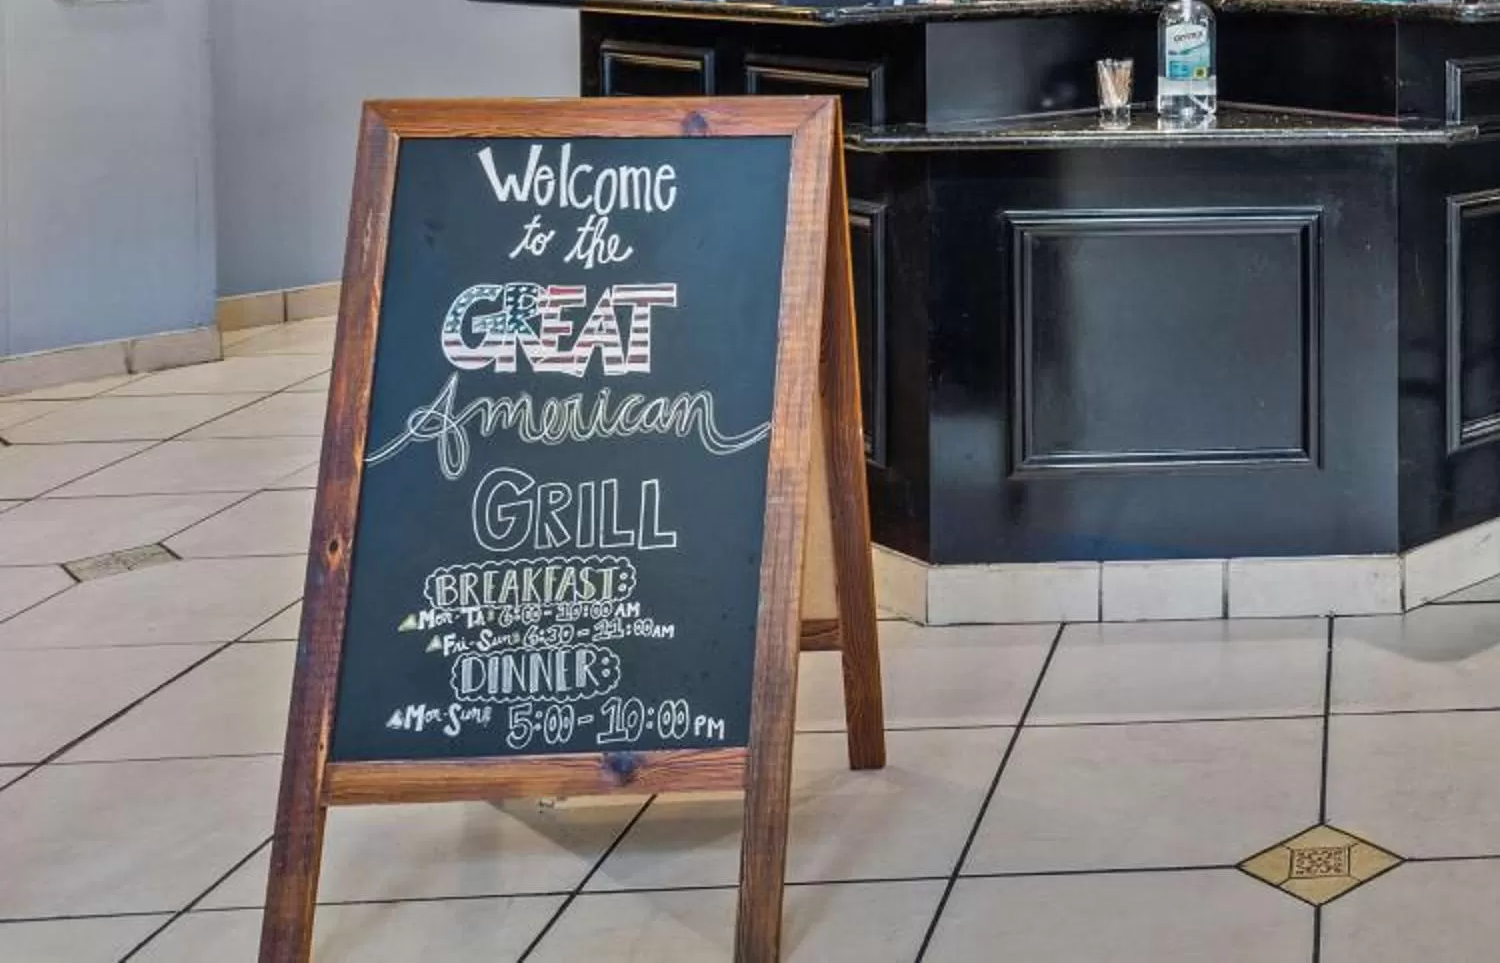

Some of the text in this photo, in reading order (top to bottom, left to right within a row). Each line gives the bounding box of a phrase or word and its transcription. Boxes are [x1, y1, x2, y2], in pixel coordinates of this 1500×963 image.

[477, 143, 678, 215] Welcome
[509, 214, 634, 269] to the
[441, 282, 678, 378] GREAT
[365, 372, 771, 479] American
[472, 466, 678, 552] GRILL
[434, 565, 629, 606] BREAKFAST:
[459, 646, 612, 694] DINNER:
[694, 714, 725, 740] PM
